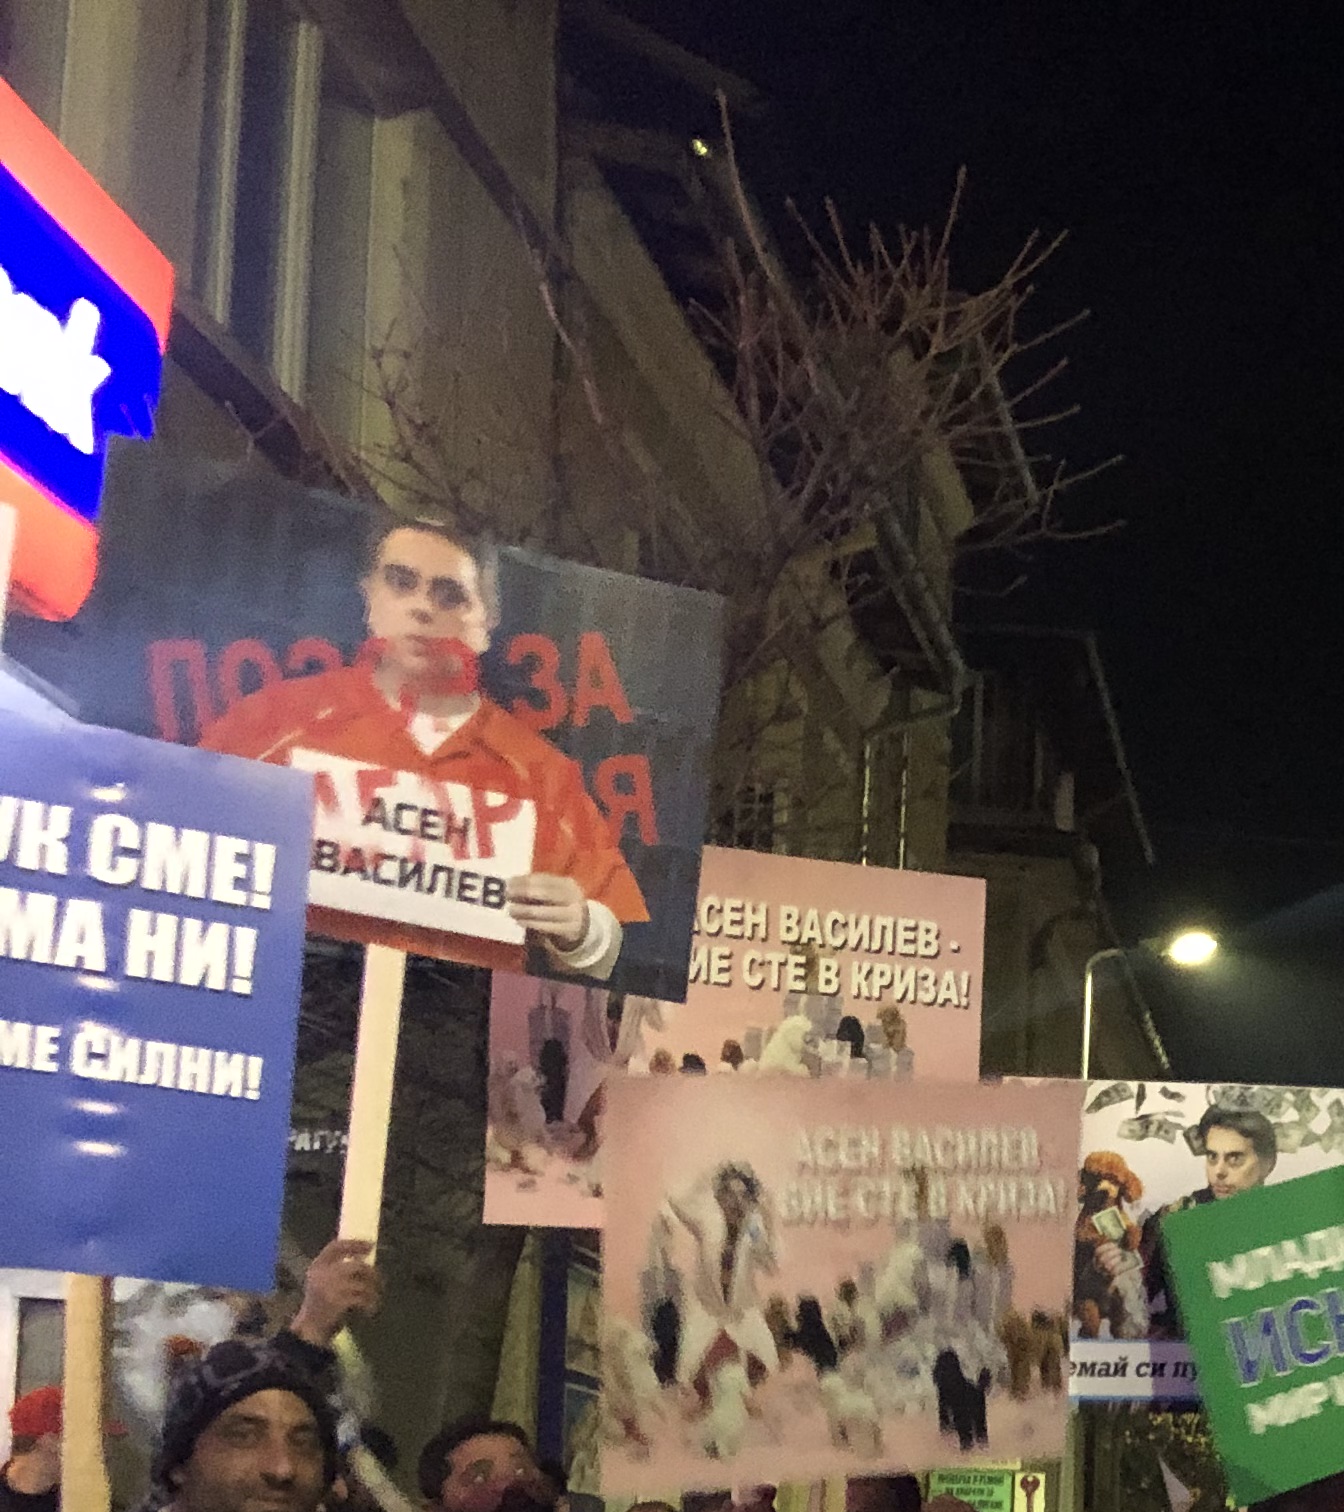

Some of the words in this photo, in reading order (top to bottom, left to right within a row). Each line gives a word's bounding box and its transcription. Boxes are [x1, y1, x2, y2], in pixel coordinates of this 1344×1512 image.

[505, 631, 636, 730] ЗА
[364, 797, 472, 846] АСЕН
[89, 813, 278, 911] СМЕ!
[315, 838, 509, 912] ВАСИЛЕВ
[0, 886, 107, 973] МА
[126, 908, 259, 995] НИ!
[693, 895, 768, 943] СЕН
[779, 903, 941, 959] ВАСИЛЕВ
[688, 945, 733, 988] ИЕ
[742, 951, 808, 996] СТЕ
[817, 957, 842, 996] В
[850, 960, 971, 1010] КРИЗА!
[0, 1018, 62, 1074] МЕ
[71, 1020, 264, 1101] СИЛНИ!
[1069, 1356, 1129, 1379] емай
[1136, 1361, 1167, 1379] си
